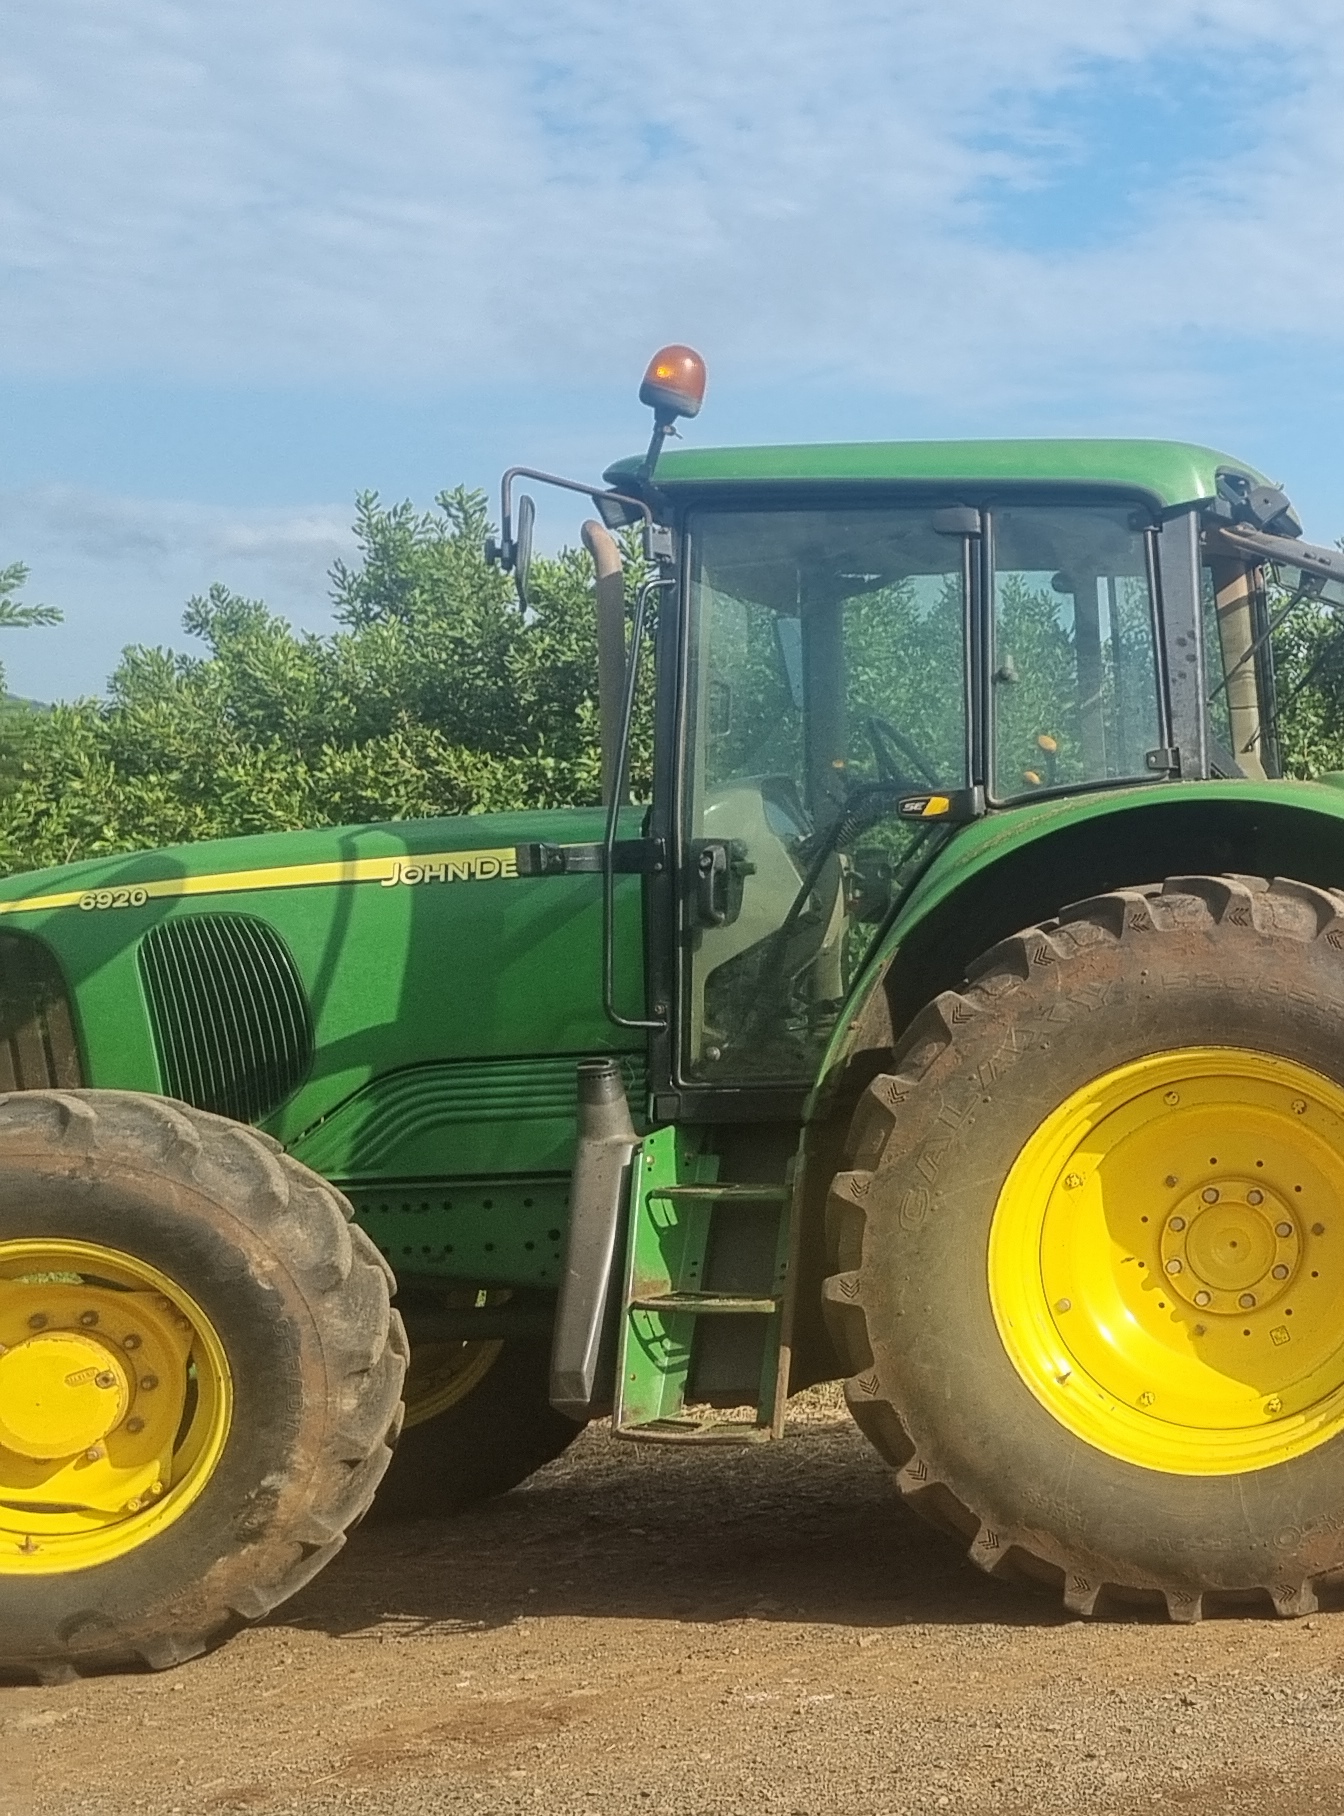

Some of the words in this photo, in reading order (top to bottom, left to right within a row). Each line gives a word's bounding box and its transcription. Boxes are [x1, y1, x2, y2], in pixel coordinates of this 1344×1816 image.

[902, 801, 927, 812] SE
[380, 862, 471, 887] JOHN
[79, 888, 148, 911] 6920
[900, 978, 1114, 1232] GALAXY
